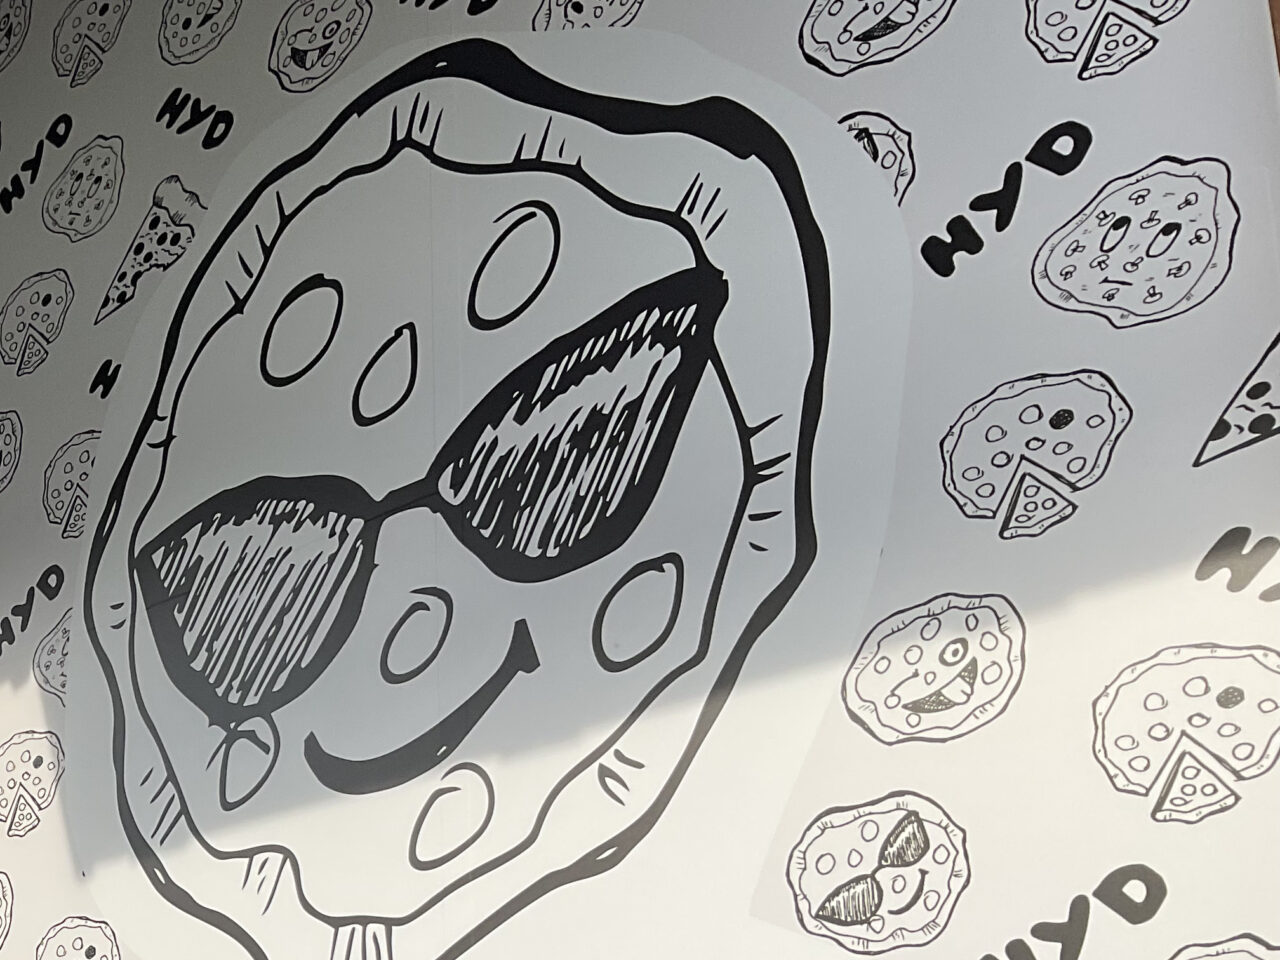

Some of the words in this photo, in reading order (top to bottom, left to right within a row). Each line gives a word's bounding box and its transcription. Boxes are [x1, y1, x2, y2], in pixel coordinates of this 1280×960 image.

[156, 88, 235, 149] HYD
[0, 114, 73, 214] HYD
[921, 121, 1093, 277] HYD
[1195, 526, 1280, 602] H
